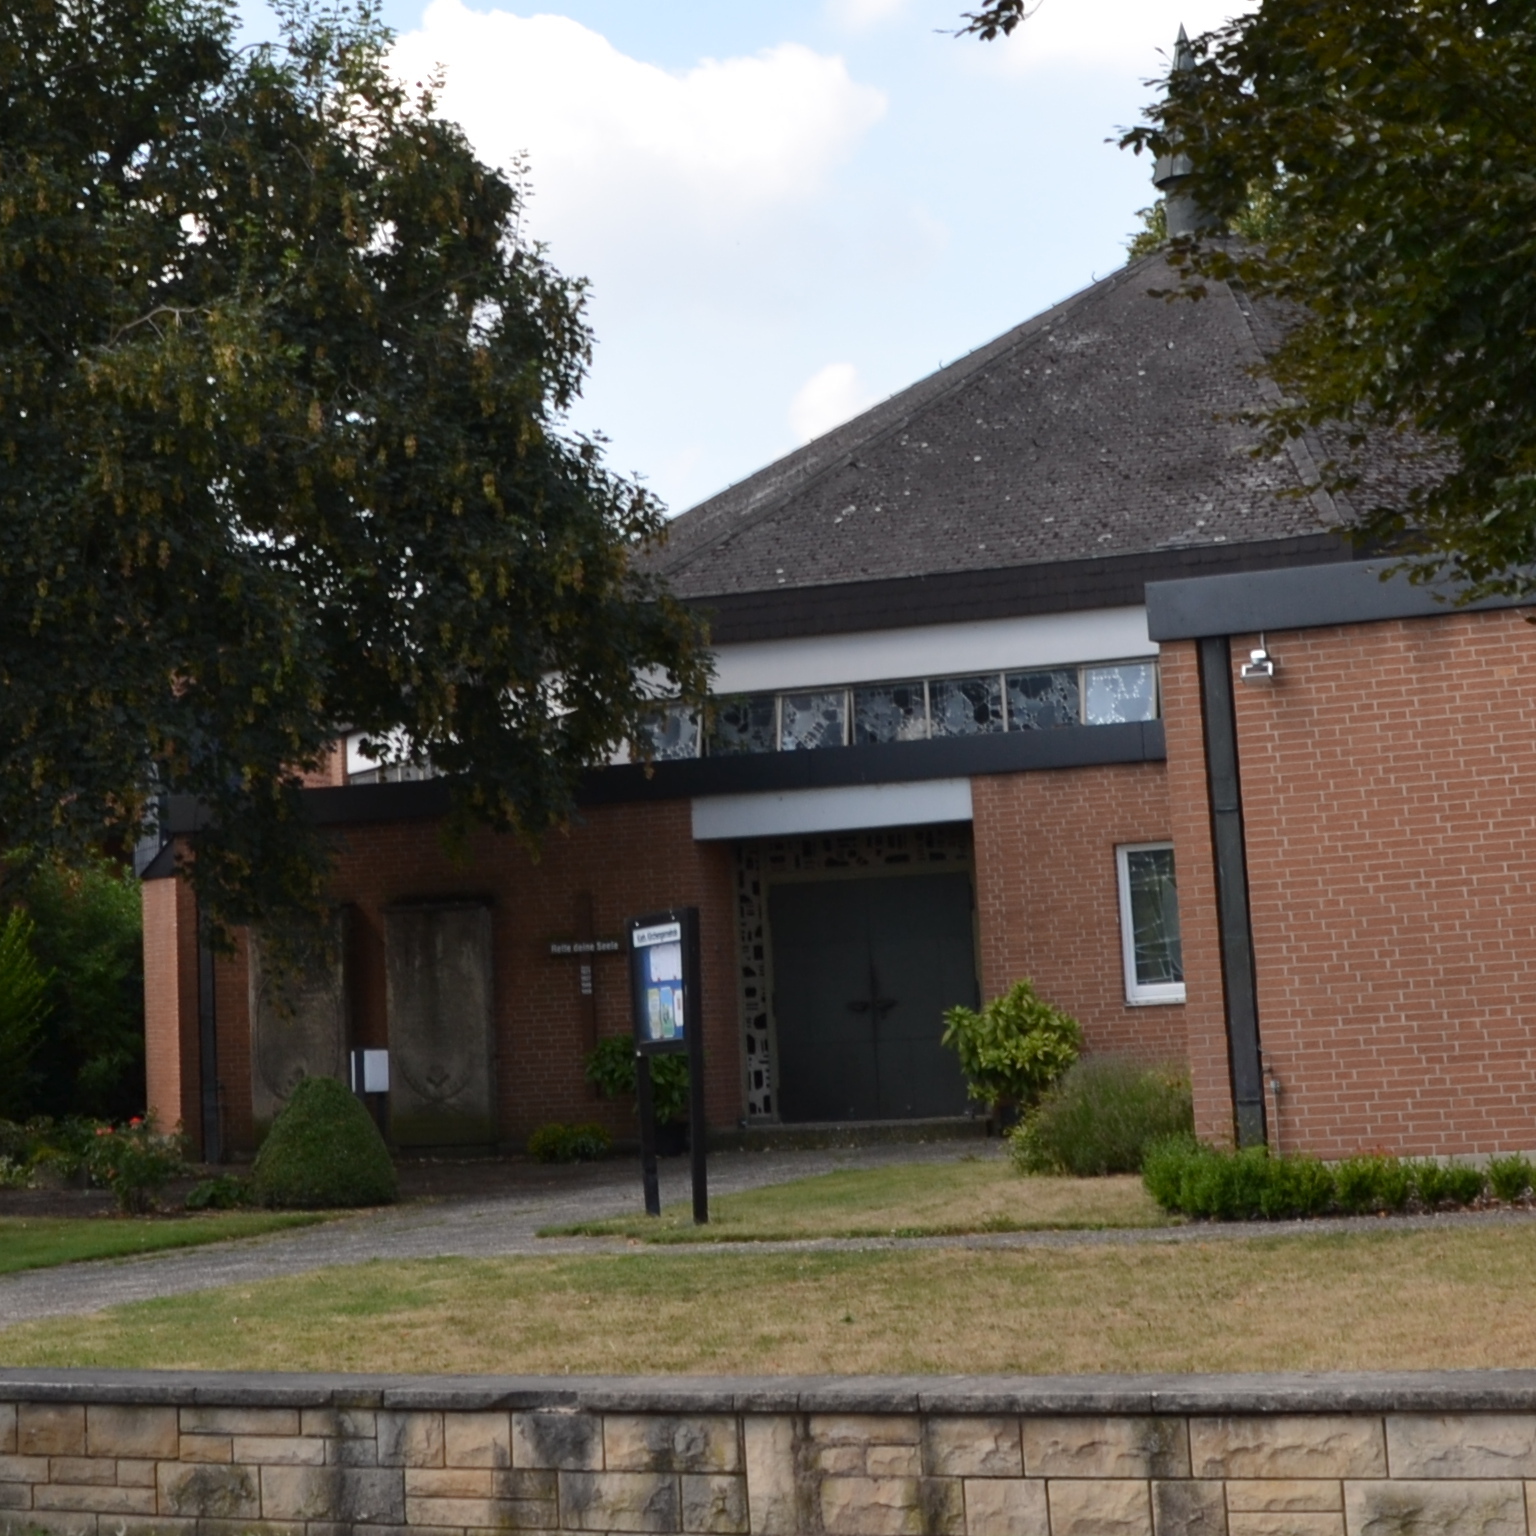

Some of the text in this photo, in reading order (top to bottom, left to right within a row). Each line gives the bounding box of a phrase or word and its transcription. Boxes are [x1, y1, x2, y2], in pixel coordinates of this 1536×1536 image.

[551, 940, 619, 954] Rette deine Seele
